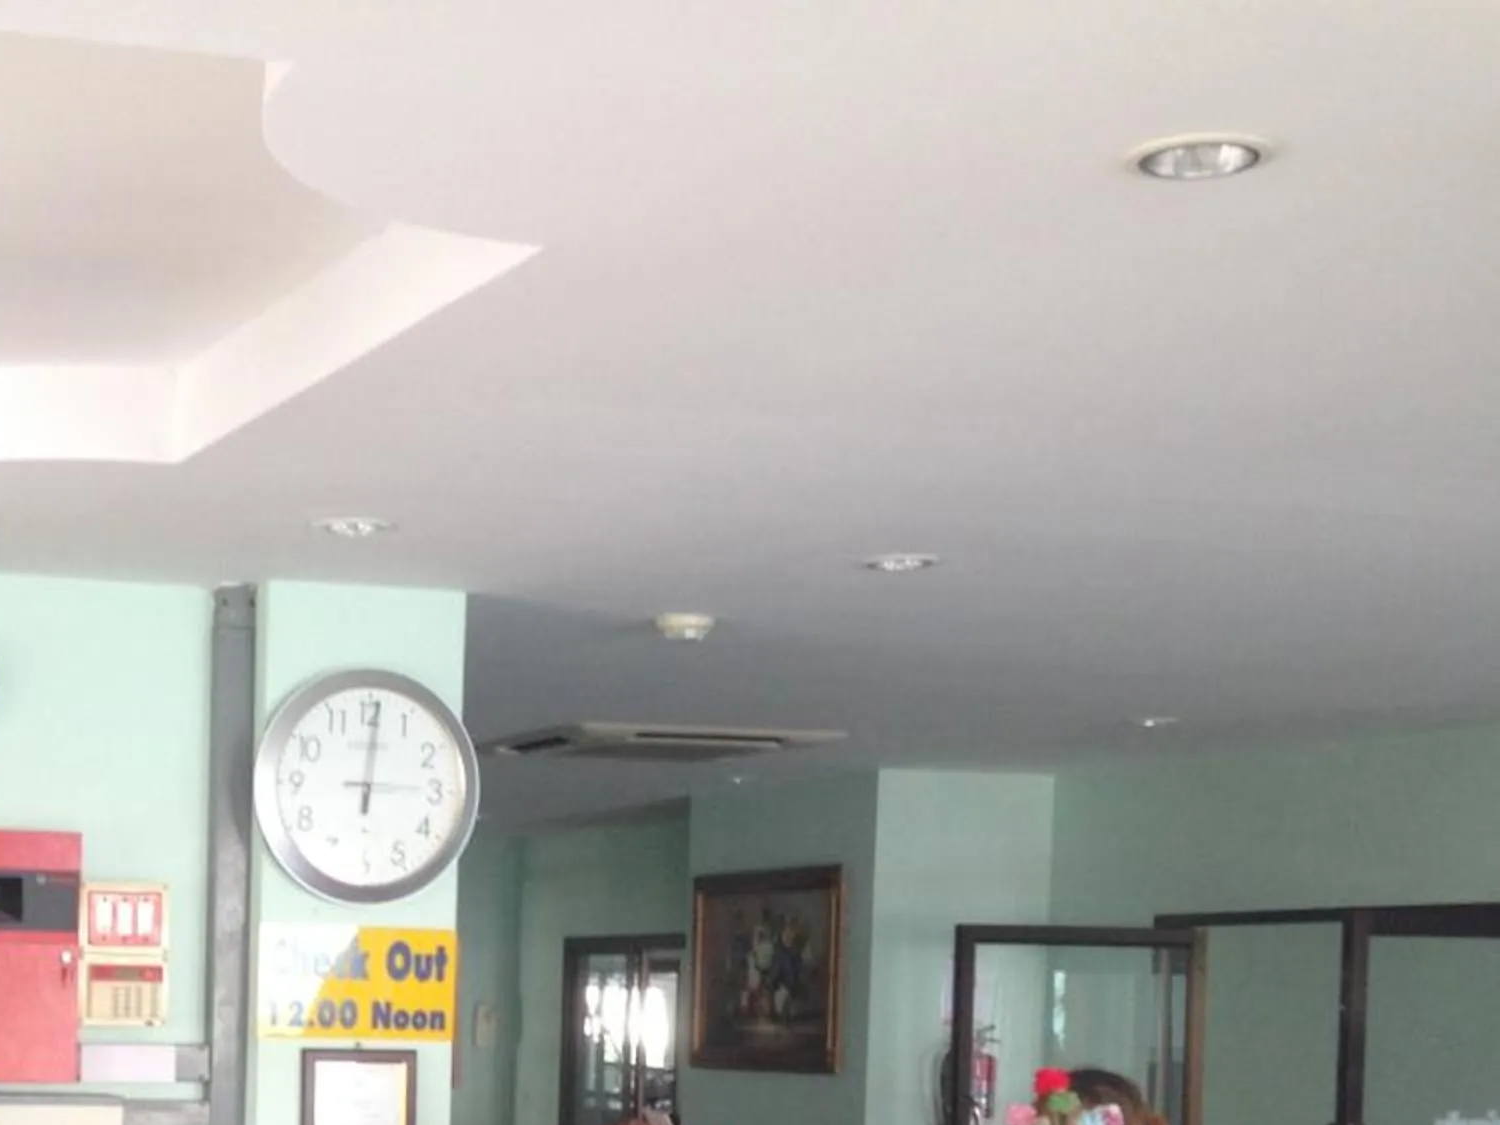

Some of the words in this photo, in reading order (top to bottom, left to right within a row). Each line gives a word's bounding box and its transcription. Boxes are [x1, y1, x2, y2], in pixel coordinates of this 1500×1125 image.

[360, 701, 381, 728] 12
[421, 741, 437, 770] 2
[426, 777, 444, 806] 3
[415, 814, 432, 837] 4
[386, 940, 449, 982] Out
[268, 997, 358, 1029] 12.00
[371, 999, 446, 1030] Noon
